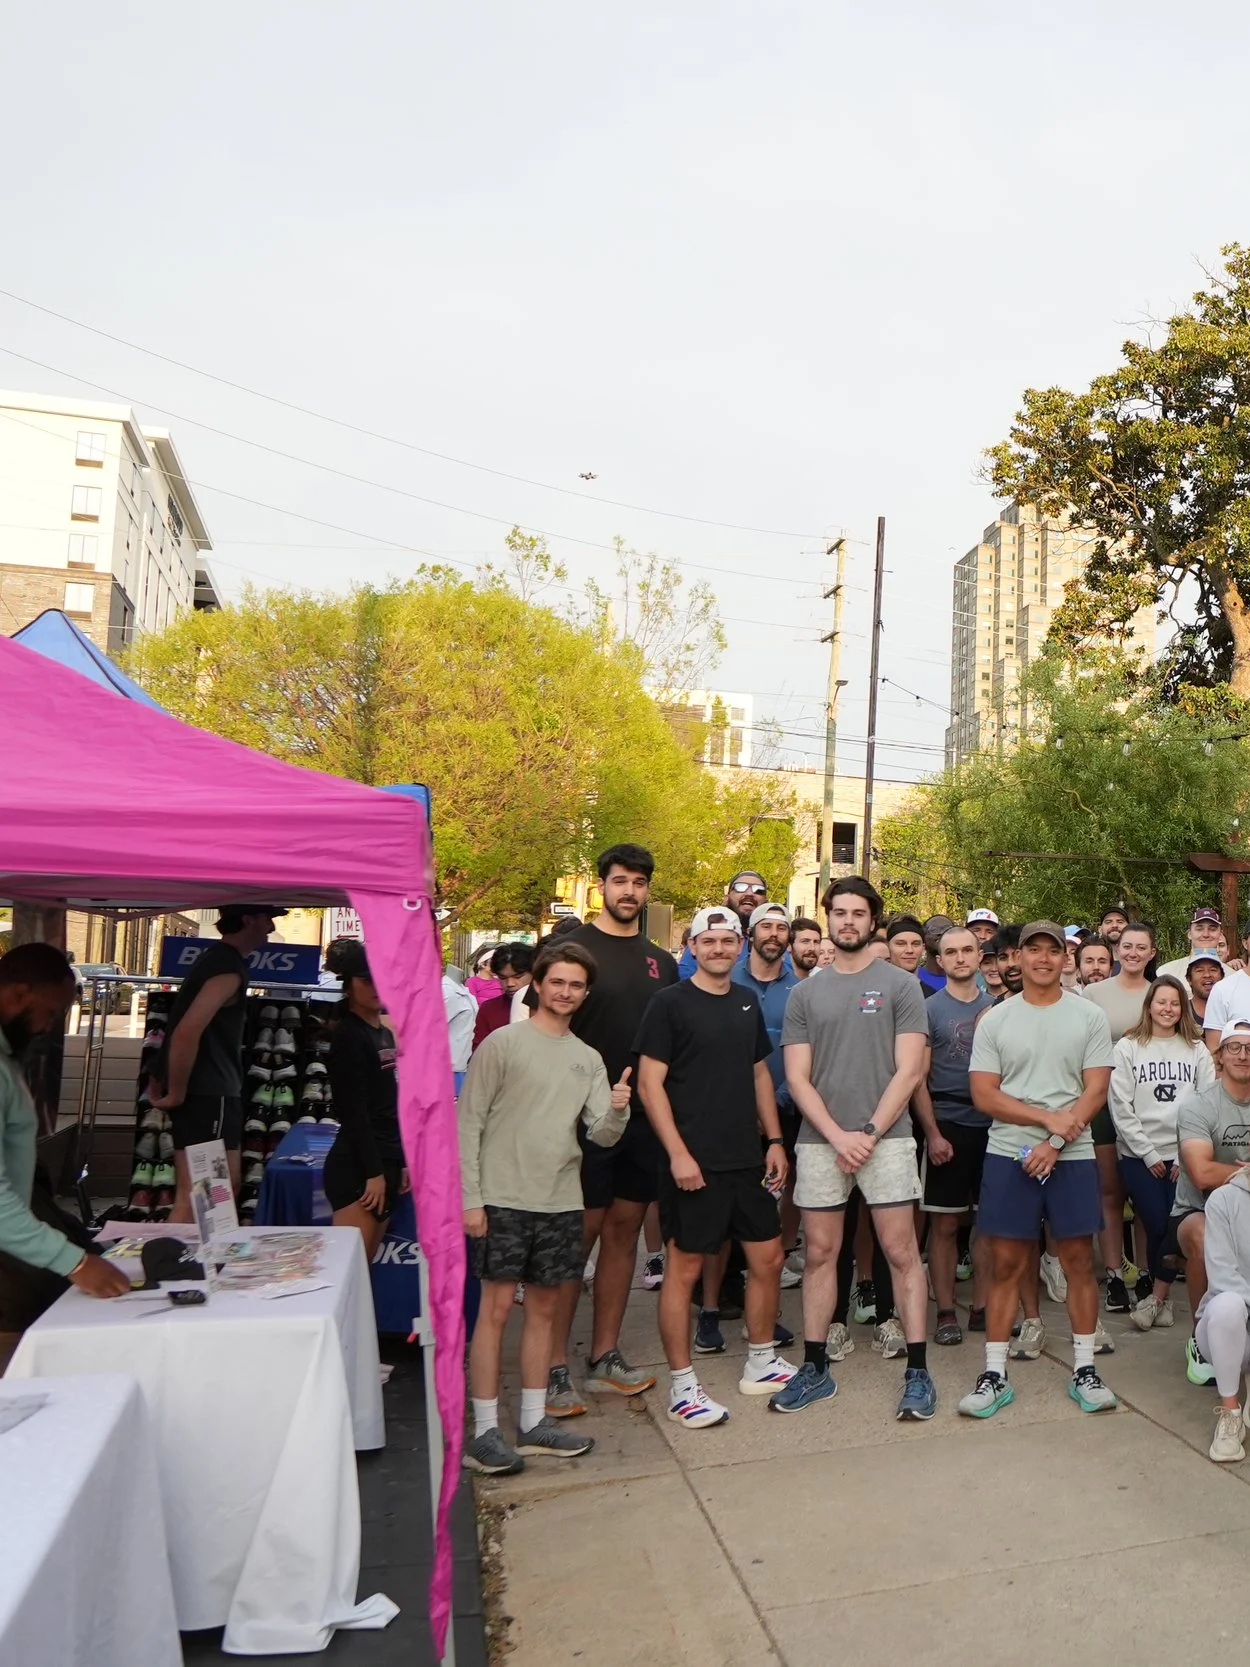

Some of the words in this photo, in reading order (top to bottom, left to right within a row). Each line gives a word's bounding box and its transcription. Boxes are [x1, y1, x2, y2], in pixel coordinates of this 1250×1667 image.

[336, 920, 361, 932] TIME
[177, 946, 298, 972] BOKS
[646, 955, 660, 979] 3
